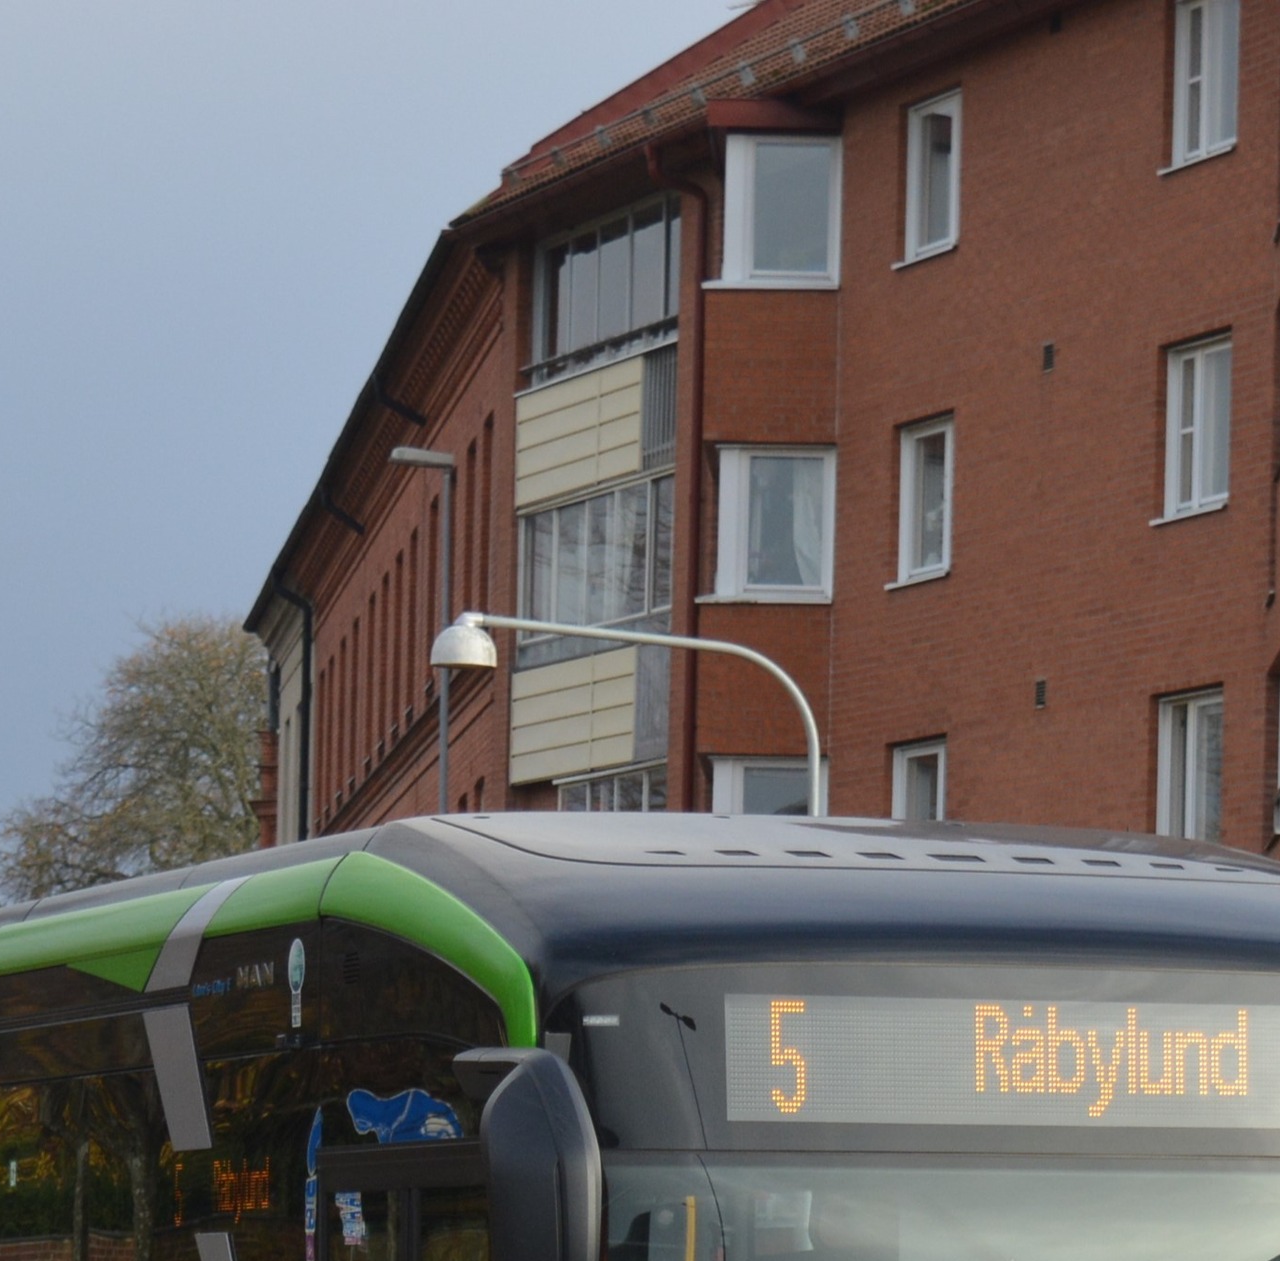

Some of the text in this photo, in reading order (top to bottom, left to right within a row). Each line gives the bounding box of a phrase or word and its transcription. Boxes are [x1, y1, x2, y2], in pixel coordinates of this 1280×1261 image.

[236, 961, 275, 988] MAN
[771, 1001, 1248, 1118] 5 Råbylund
